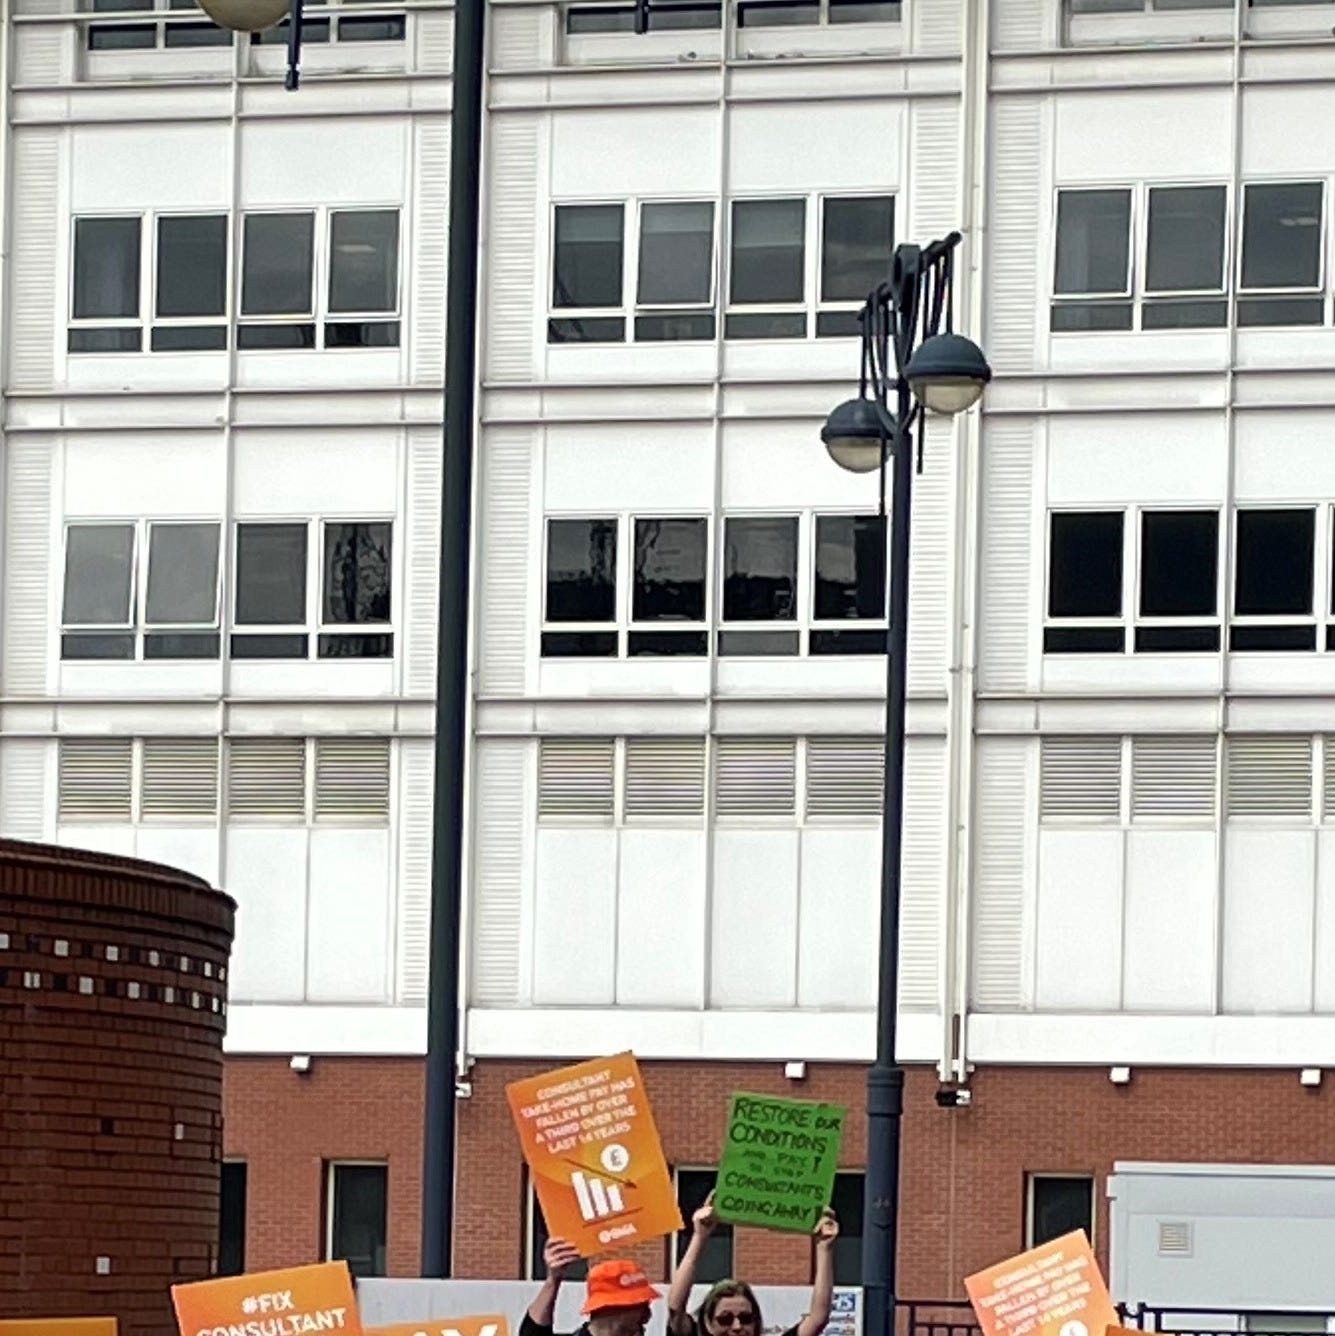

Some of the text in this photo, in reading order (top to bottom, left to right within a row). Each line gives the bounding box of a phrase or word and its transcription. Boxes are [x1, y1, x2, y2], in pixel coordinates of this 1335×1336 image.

[734, 1097, 812, 1128] RESTORE
[730, 1122, 828, 1154] CONDITIONS
[241, 1290, 295, 1315] #FIX
